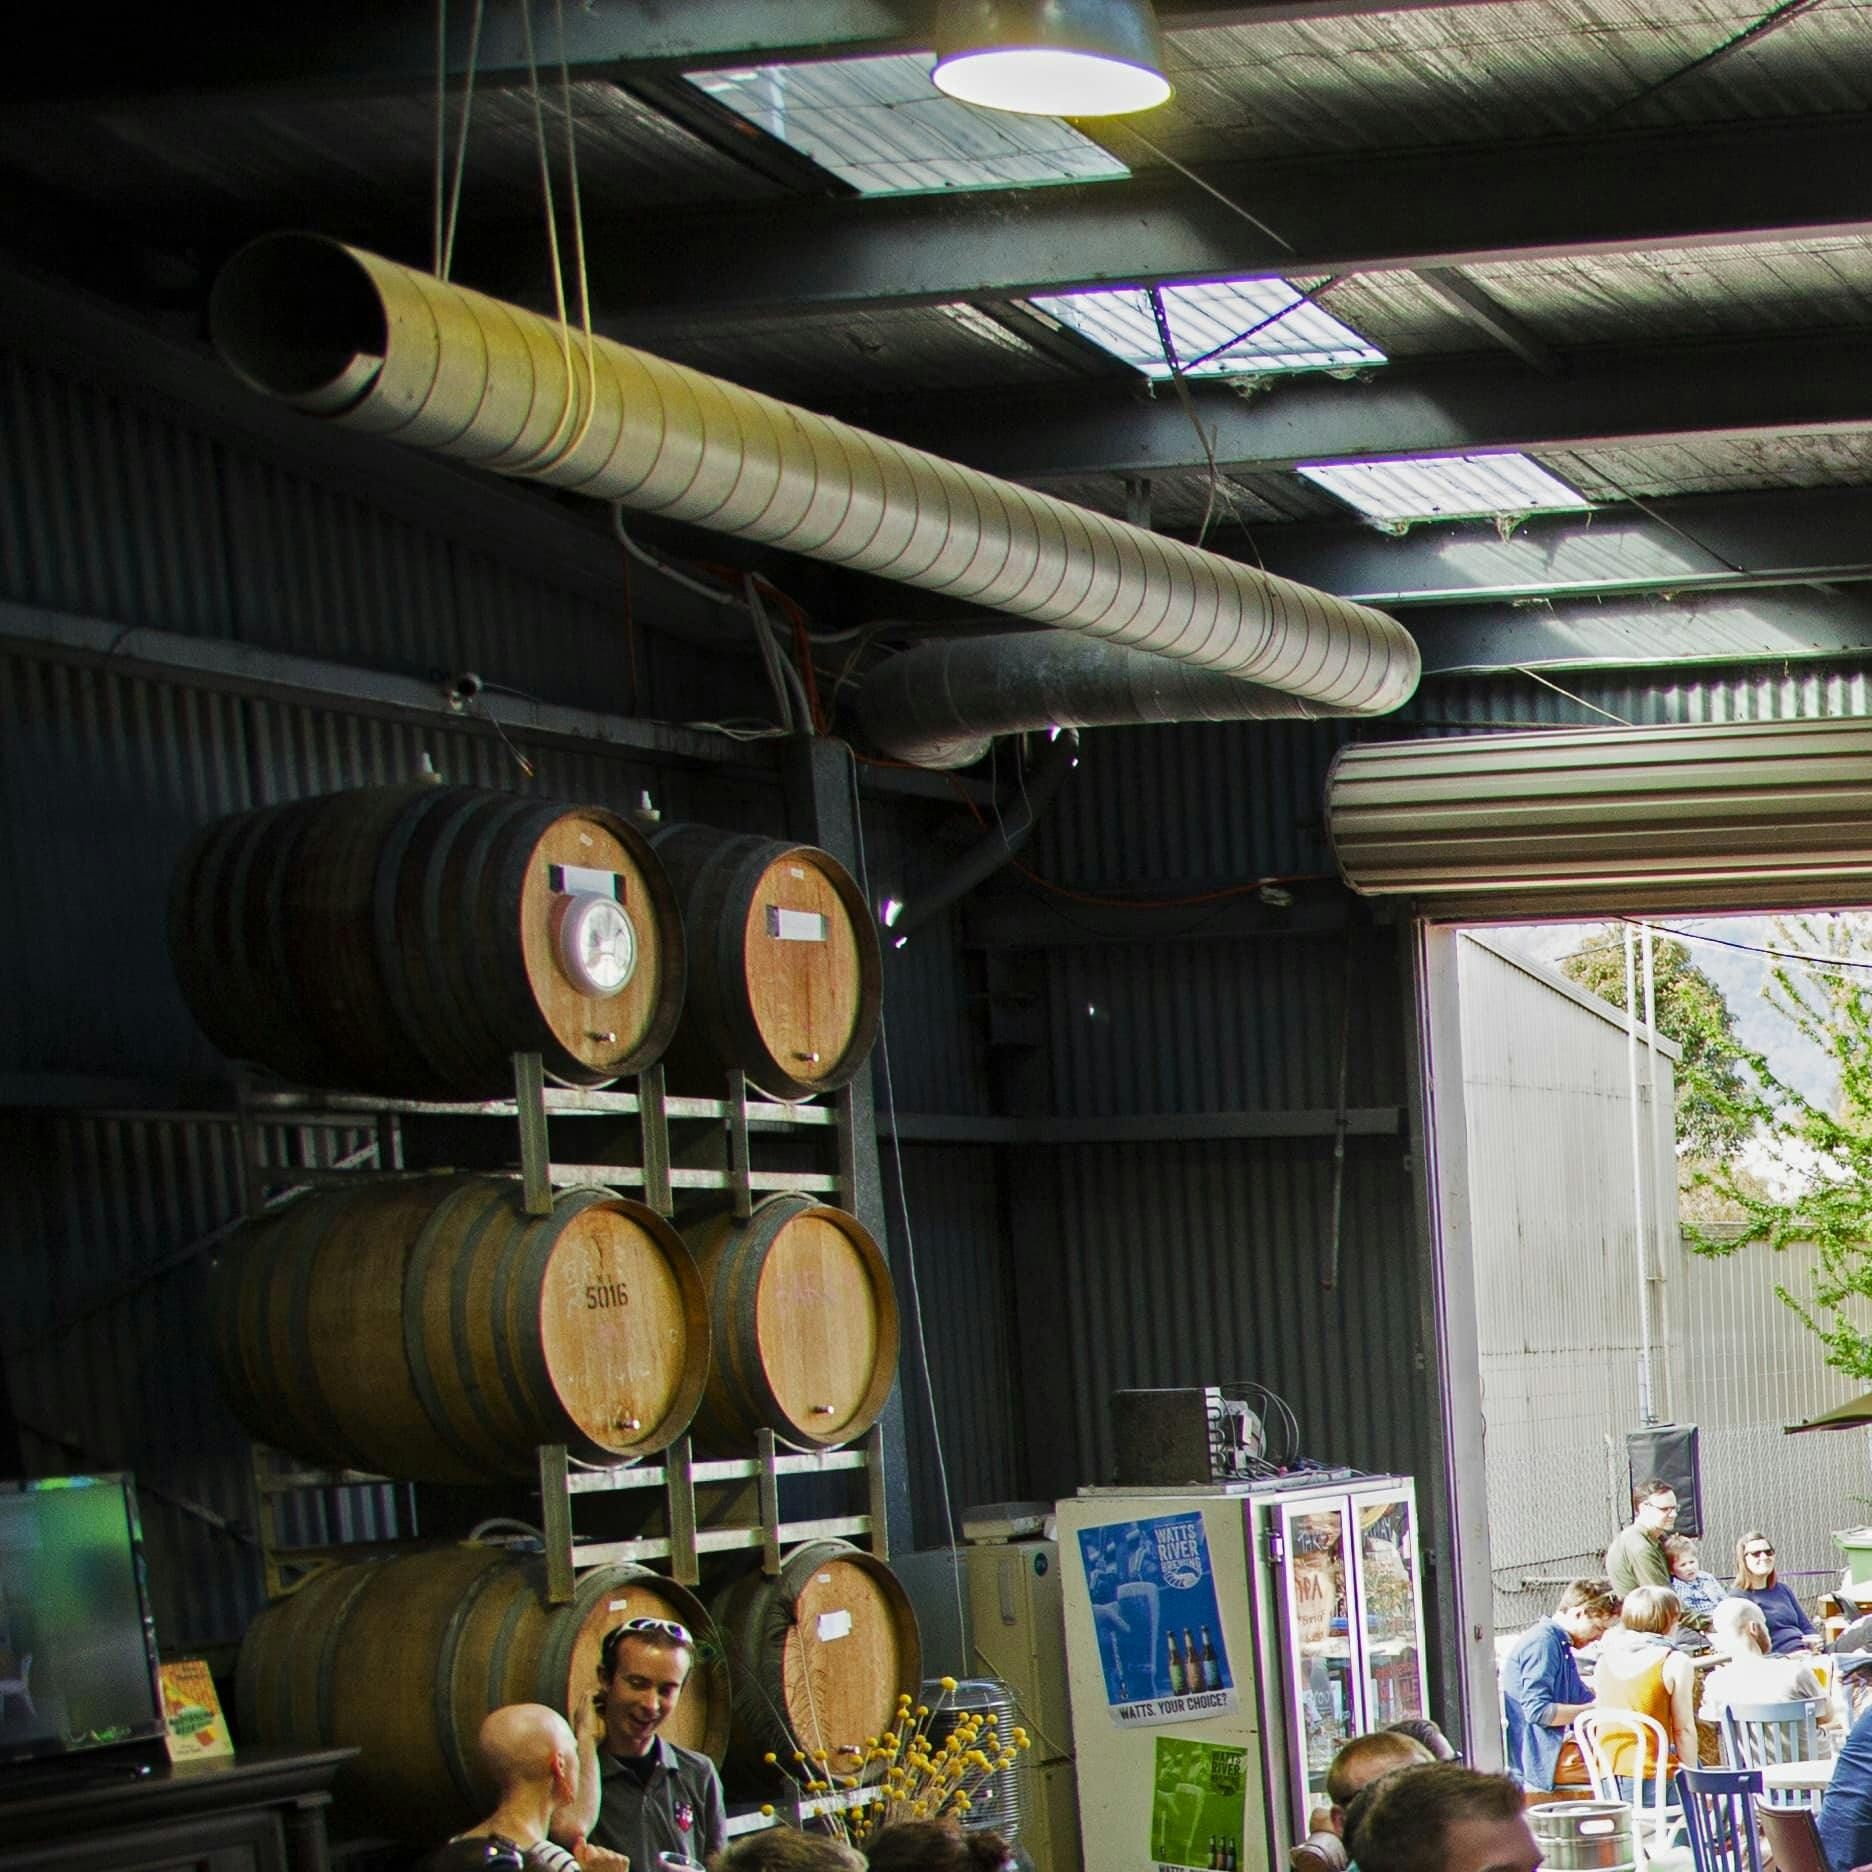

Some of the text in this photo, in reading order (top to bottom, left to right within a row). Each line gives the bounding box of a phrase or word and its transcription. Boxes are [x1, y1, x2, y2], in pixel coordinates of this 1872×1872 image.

[1154, 1524, 1197, 1544] WATTS
[1158, 1541, 1199, 1561] RIVER
[1160, 1558, 1201, 1573] BREWING
[1158, 1699, 1185, 1716] YOUR
[1186, 1693, 1228, 1712] CHOICE?
[1212, 1761, 1241, 1776] RIVER
